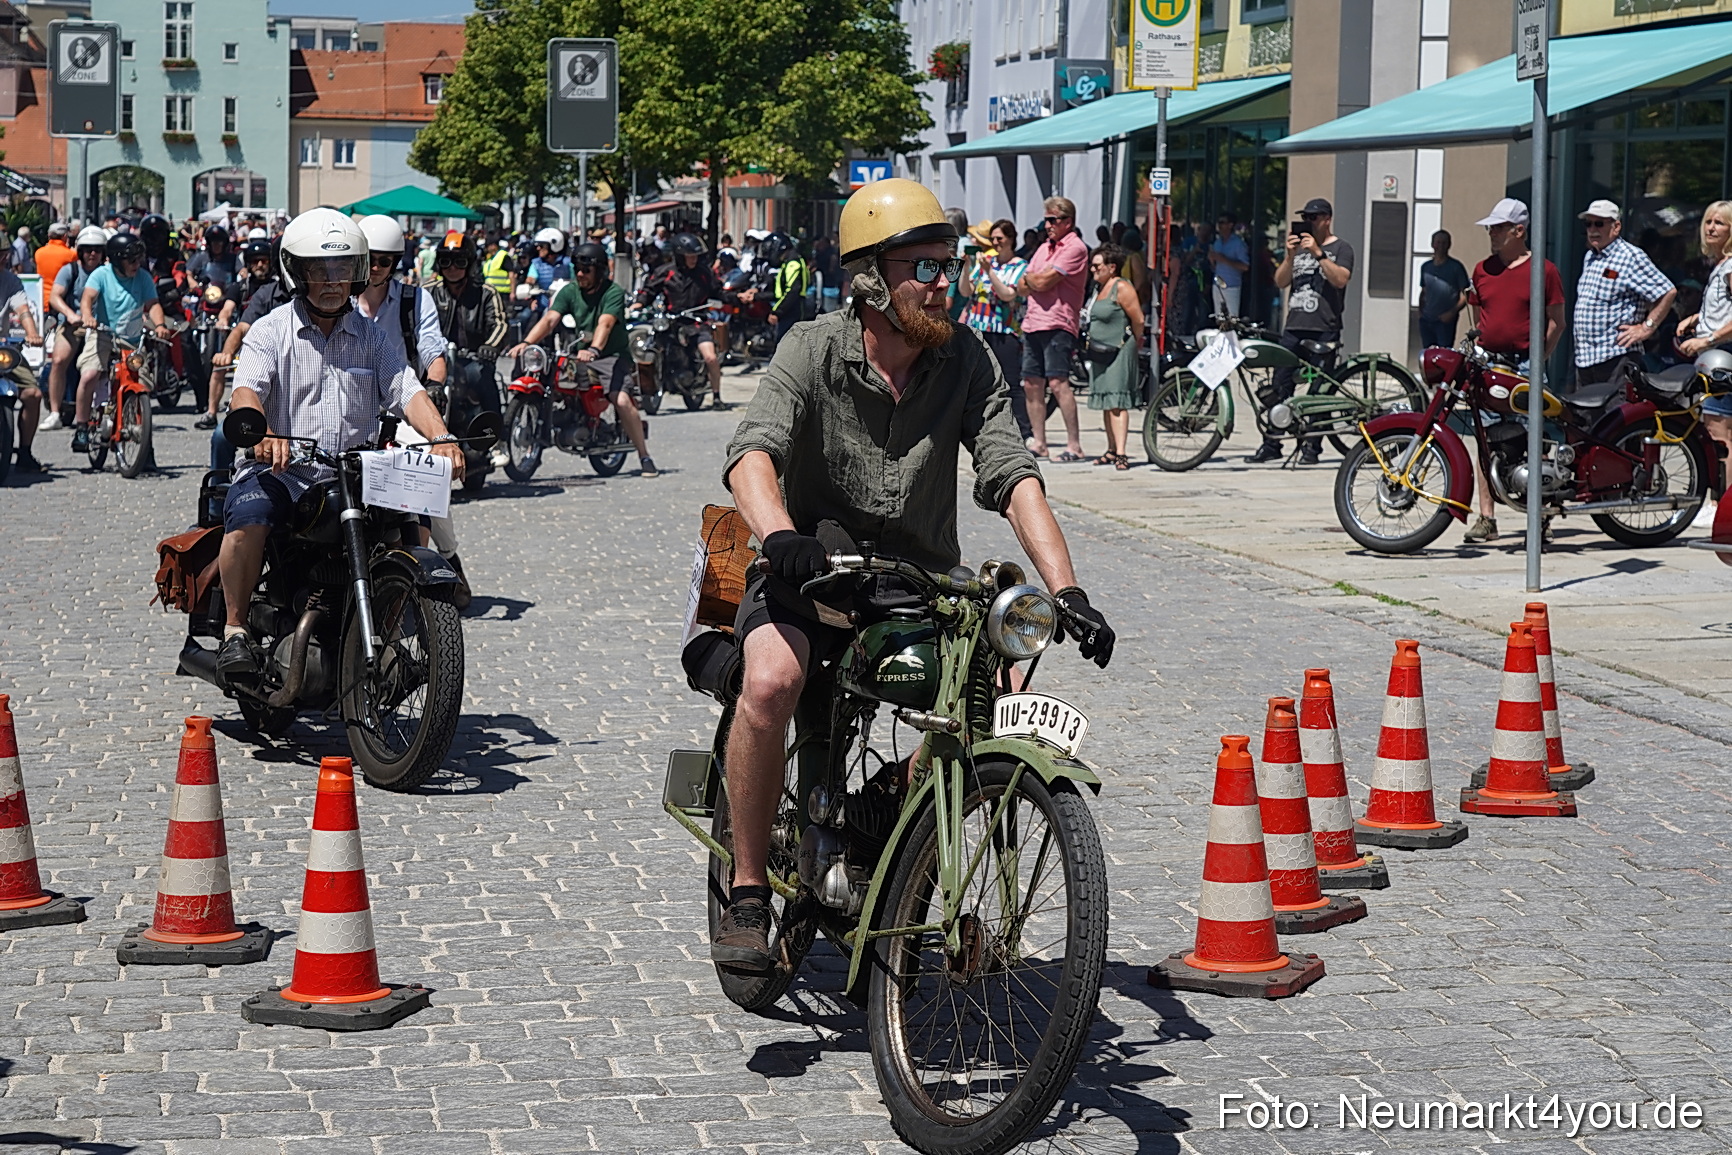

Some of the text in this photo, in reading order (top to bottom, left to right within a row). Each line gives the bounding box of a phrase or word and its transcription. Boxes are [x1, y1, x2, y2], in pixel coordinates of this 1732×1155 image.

[1147, 32, 1181, 40] Rathaus
[72, 71, 97, 81] ZONE
[571, 87, 596, 97] ZONE
[404, 451, 435, 469] 174
[876, 672, 926, 682] EXPRESS
